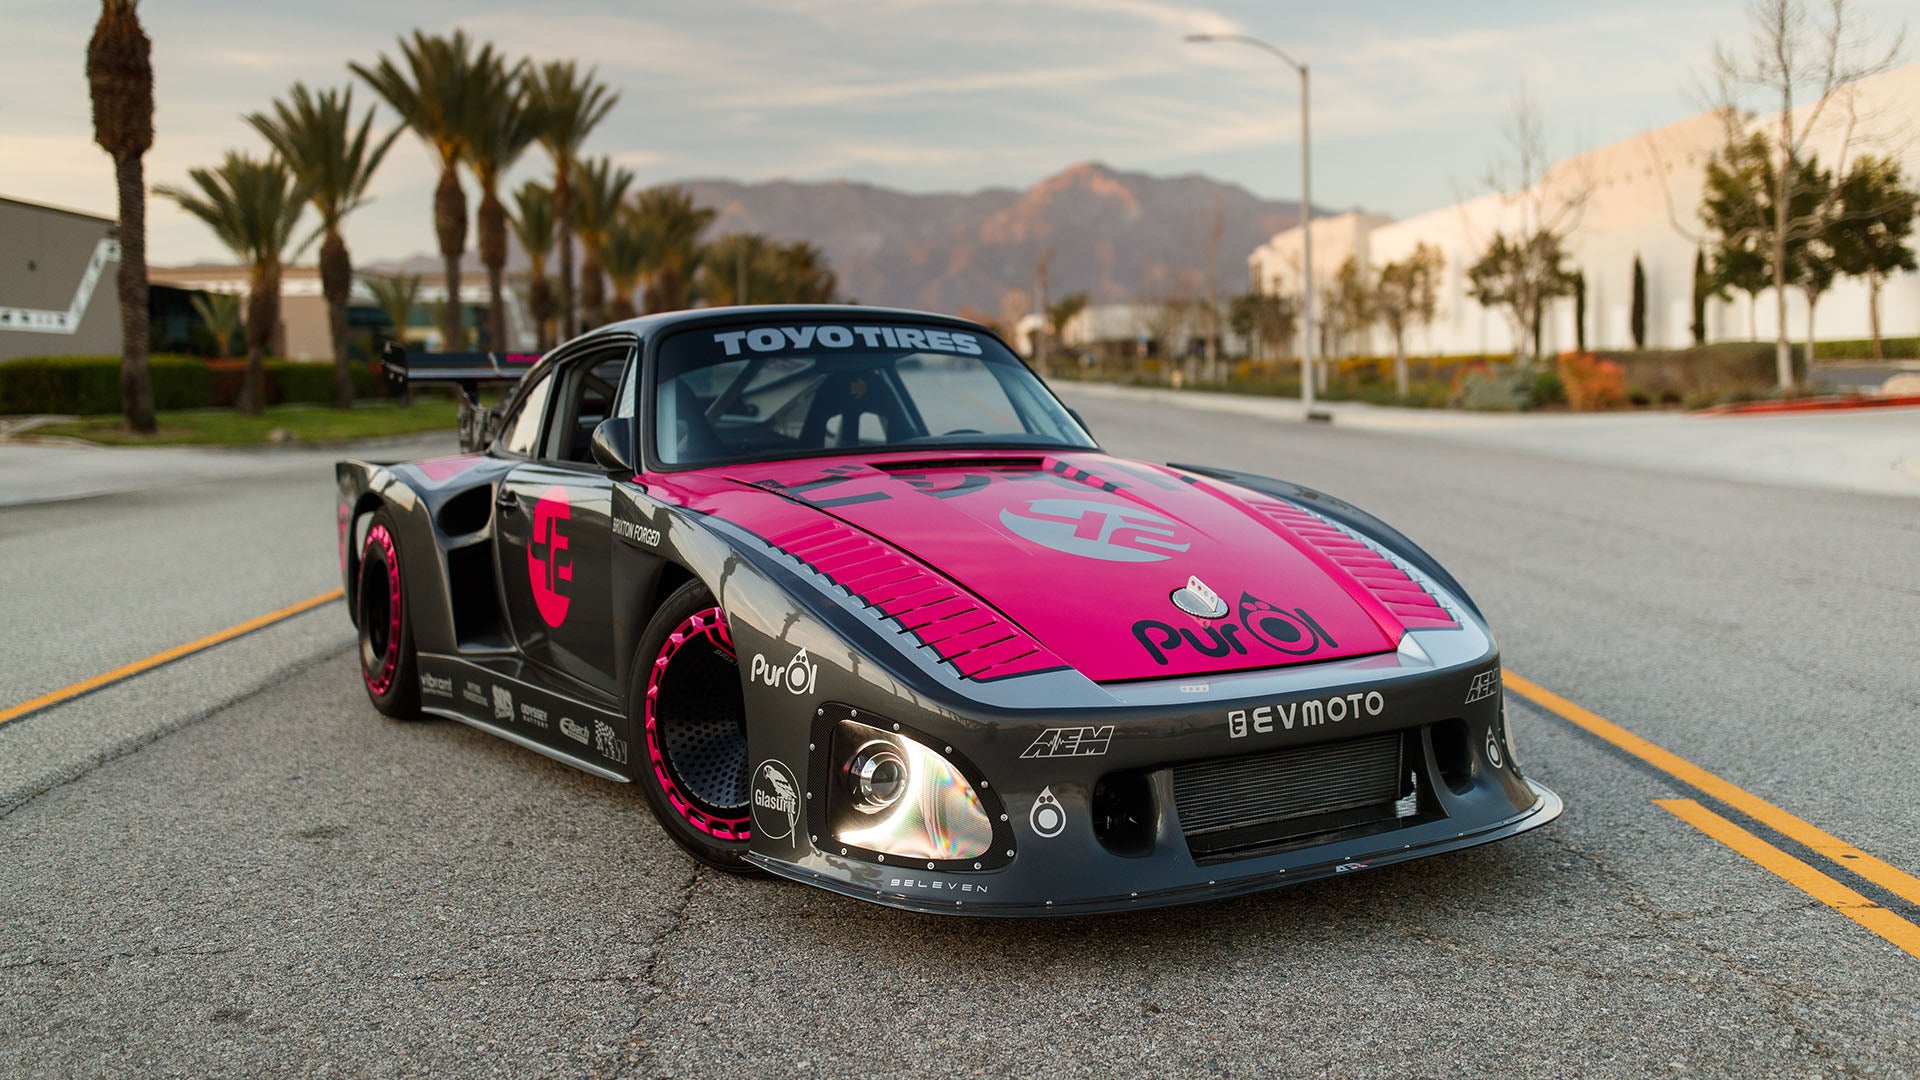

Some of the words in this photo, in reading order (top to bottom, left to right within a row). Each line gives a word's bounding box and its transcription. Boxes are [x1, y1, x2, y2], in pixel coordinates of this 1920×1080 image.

[713, 325, 854, 356] TOYO
[854, 330, 983, 355] TIRES
[612, 516, 635, 539] BRIXTON
[633, 524, 661, 547] FORGED
[520, 702, 549, 723] ODYSSEY
[1252, 690, 1385, 735] EVMOTO
[1018, 725, 1115, 759] AEM
[755, 788, 796, 815] Glasurit
[889, 878, 989, 893] 9ELEVEN
